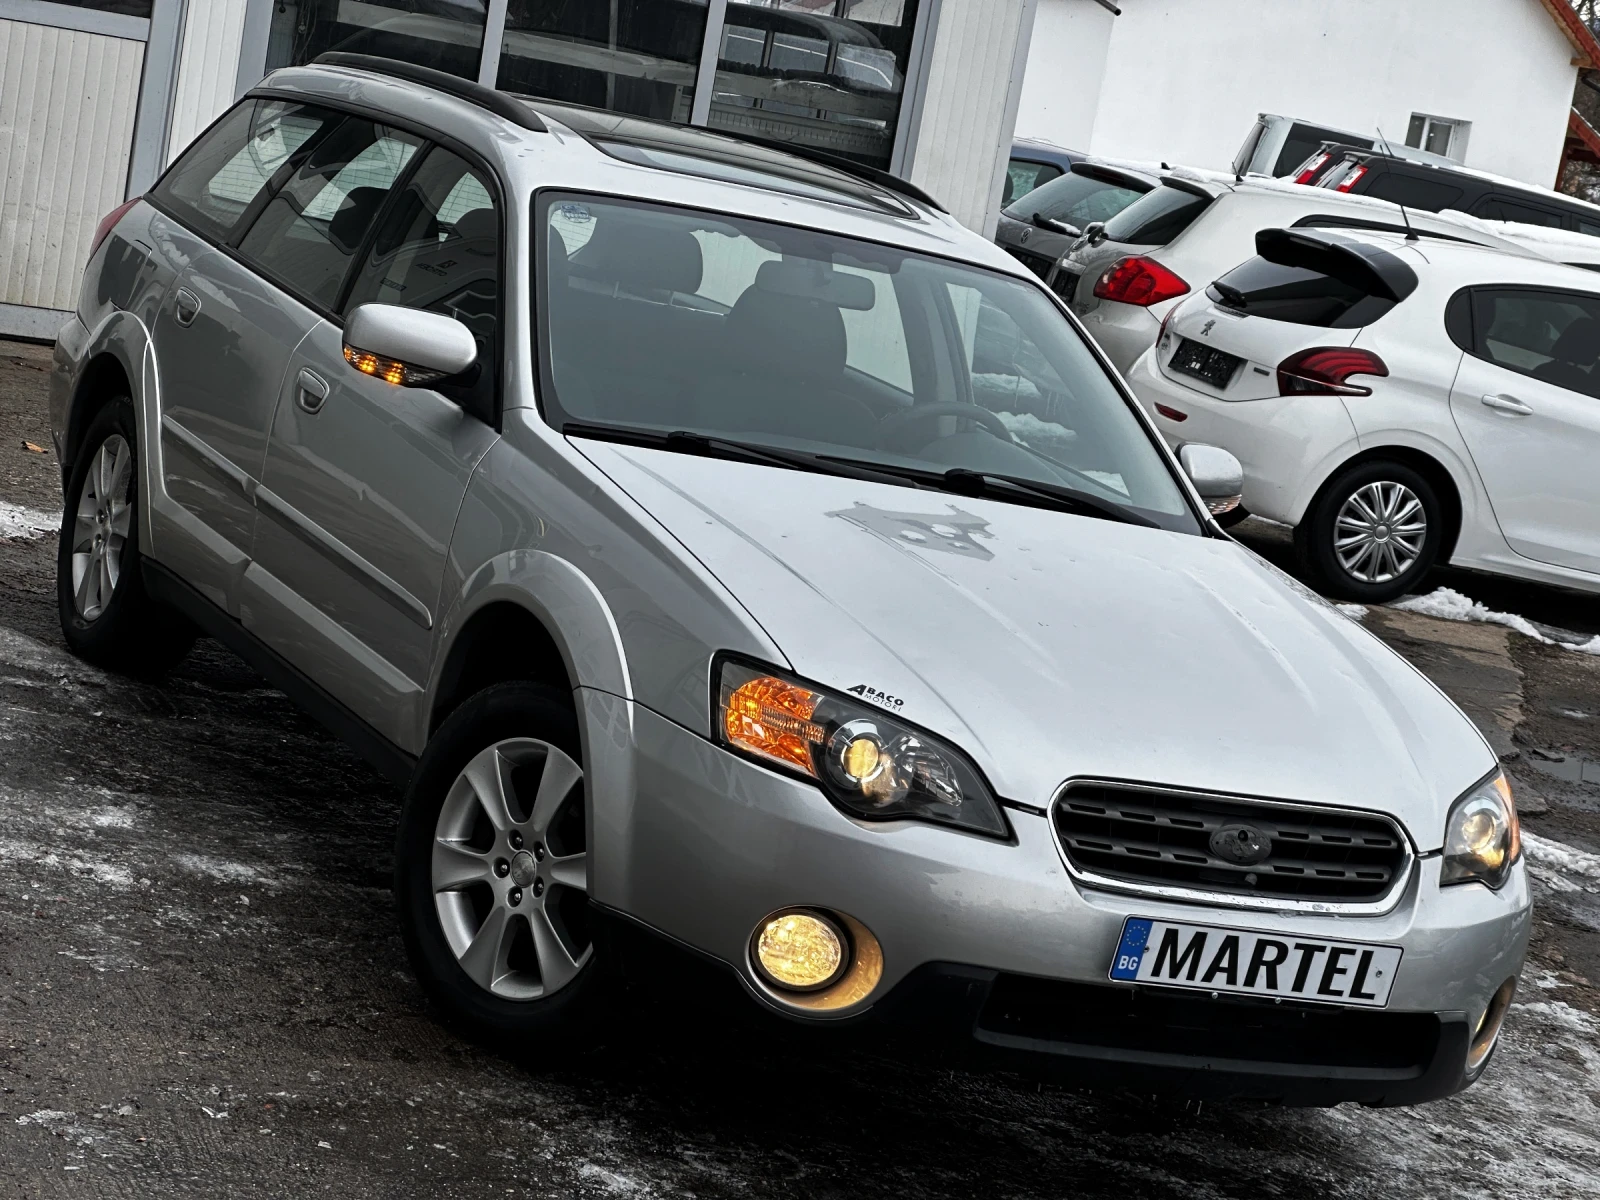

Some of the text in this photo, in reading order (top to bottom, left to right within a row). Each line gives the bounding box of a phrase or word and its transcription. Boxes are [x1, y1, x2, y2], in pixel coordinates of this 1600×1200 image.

[846, 684, 904, 706] ABACO
[864, 693, 902, 712] MOTORI
[1118, 955, 1139, 971] BG
[1150, 927, 1377, 1000] MARTEL
